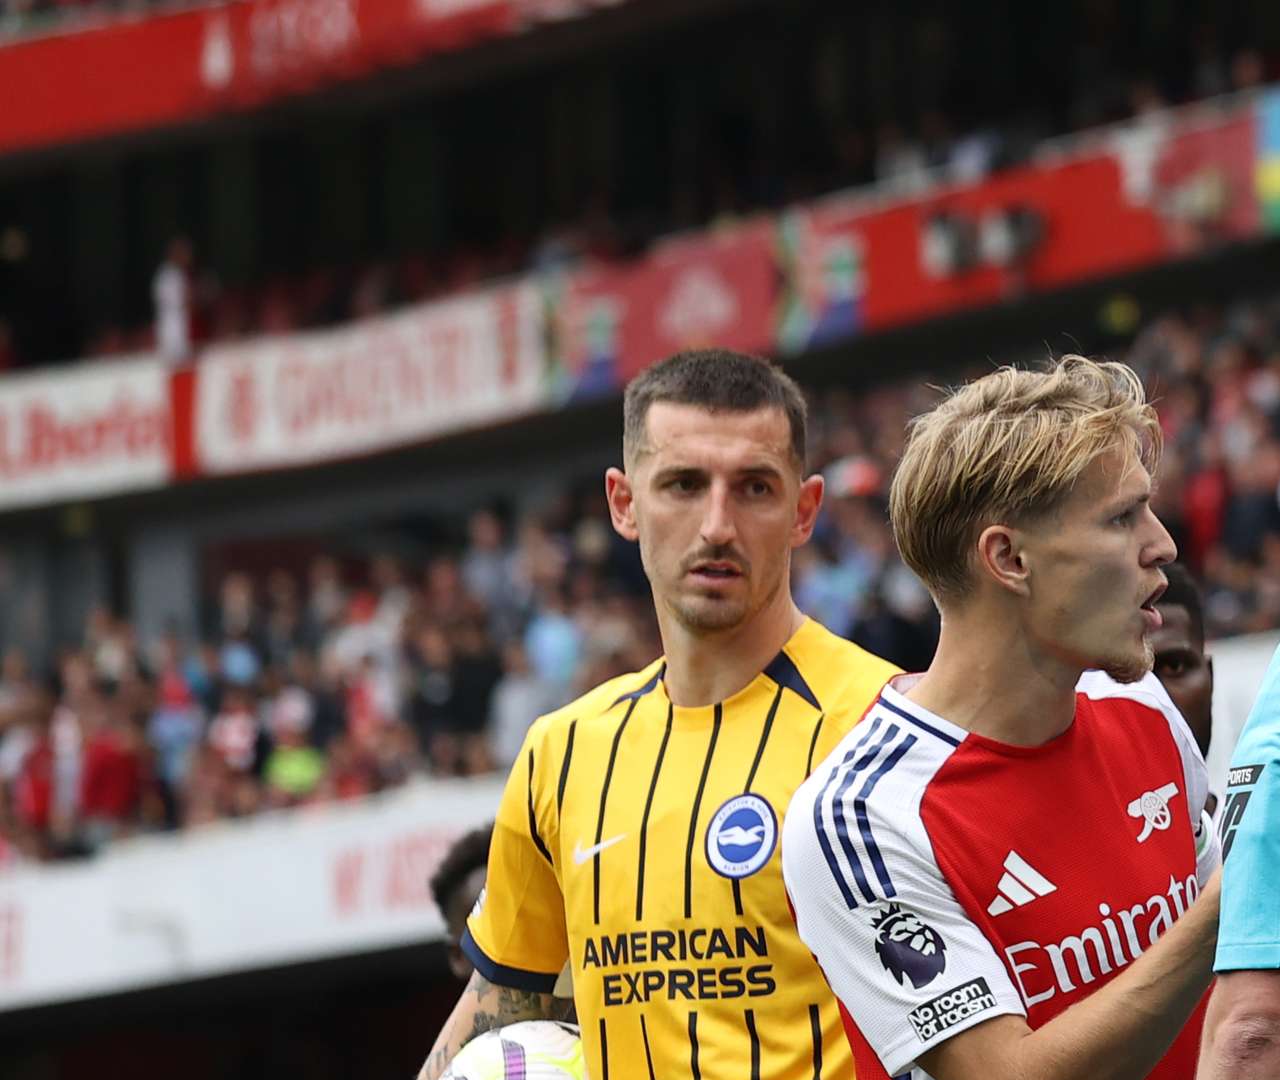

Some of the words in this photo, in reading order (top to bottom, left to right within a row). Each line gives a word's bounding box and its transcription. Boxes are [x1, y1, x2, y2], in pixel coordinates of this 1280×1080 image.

[583, 926, 768, 970] AMERICAN
[603, 964, 776, 1006] EXPRESS
[908, 1006, 934, 1031] No
[933, 983, 983, 1015] room
